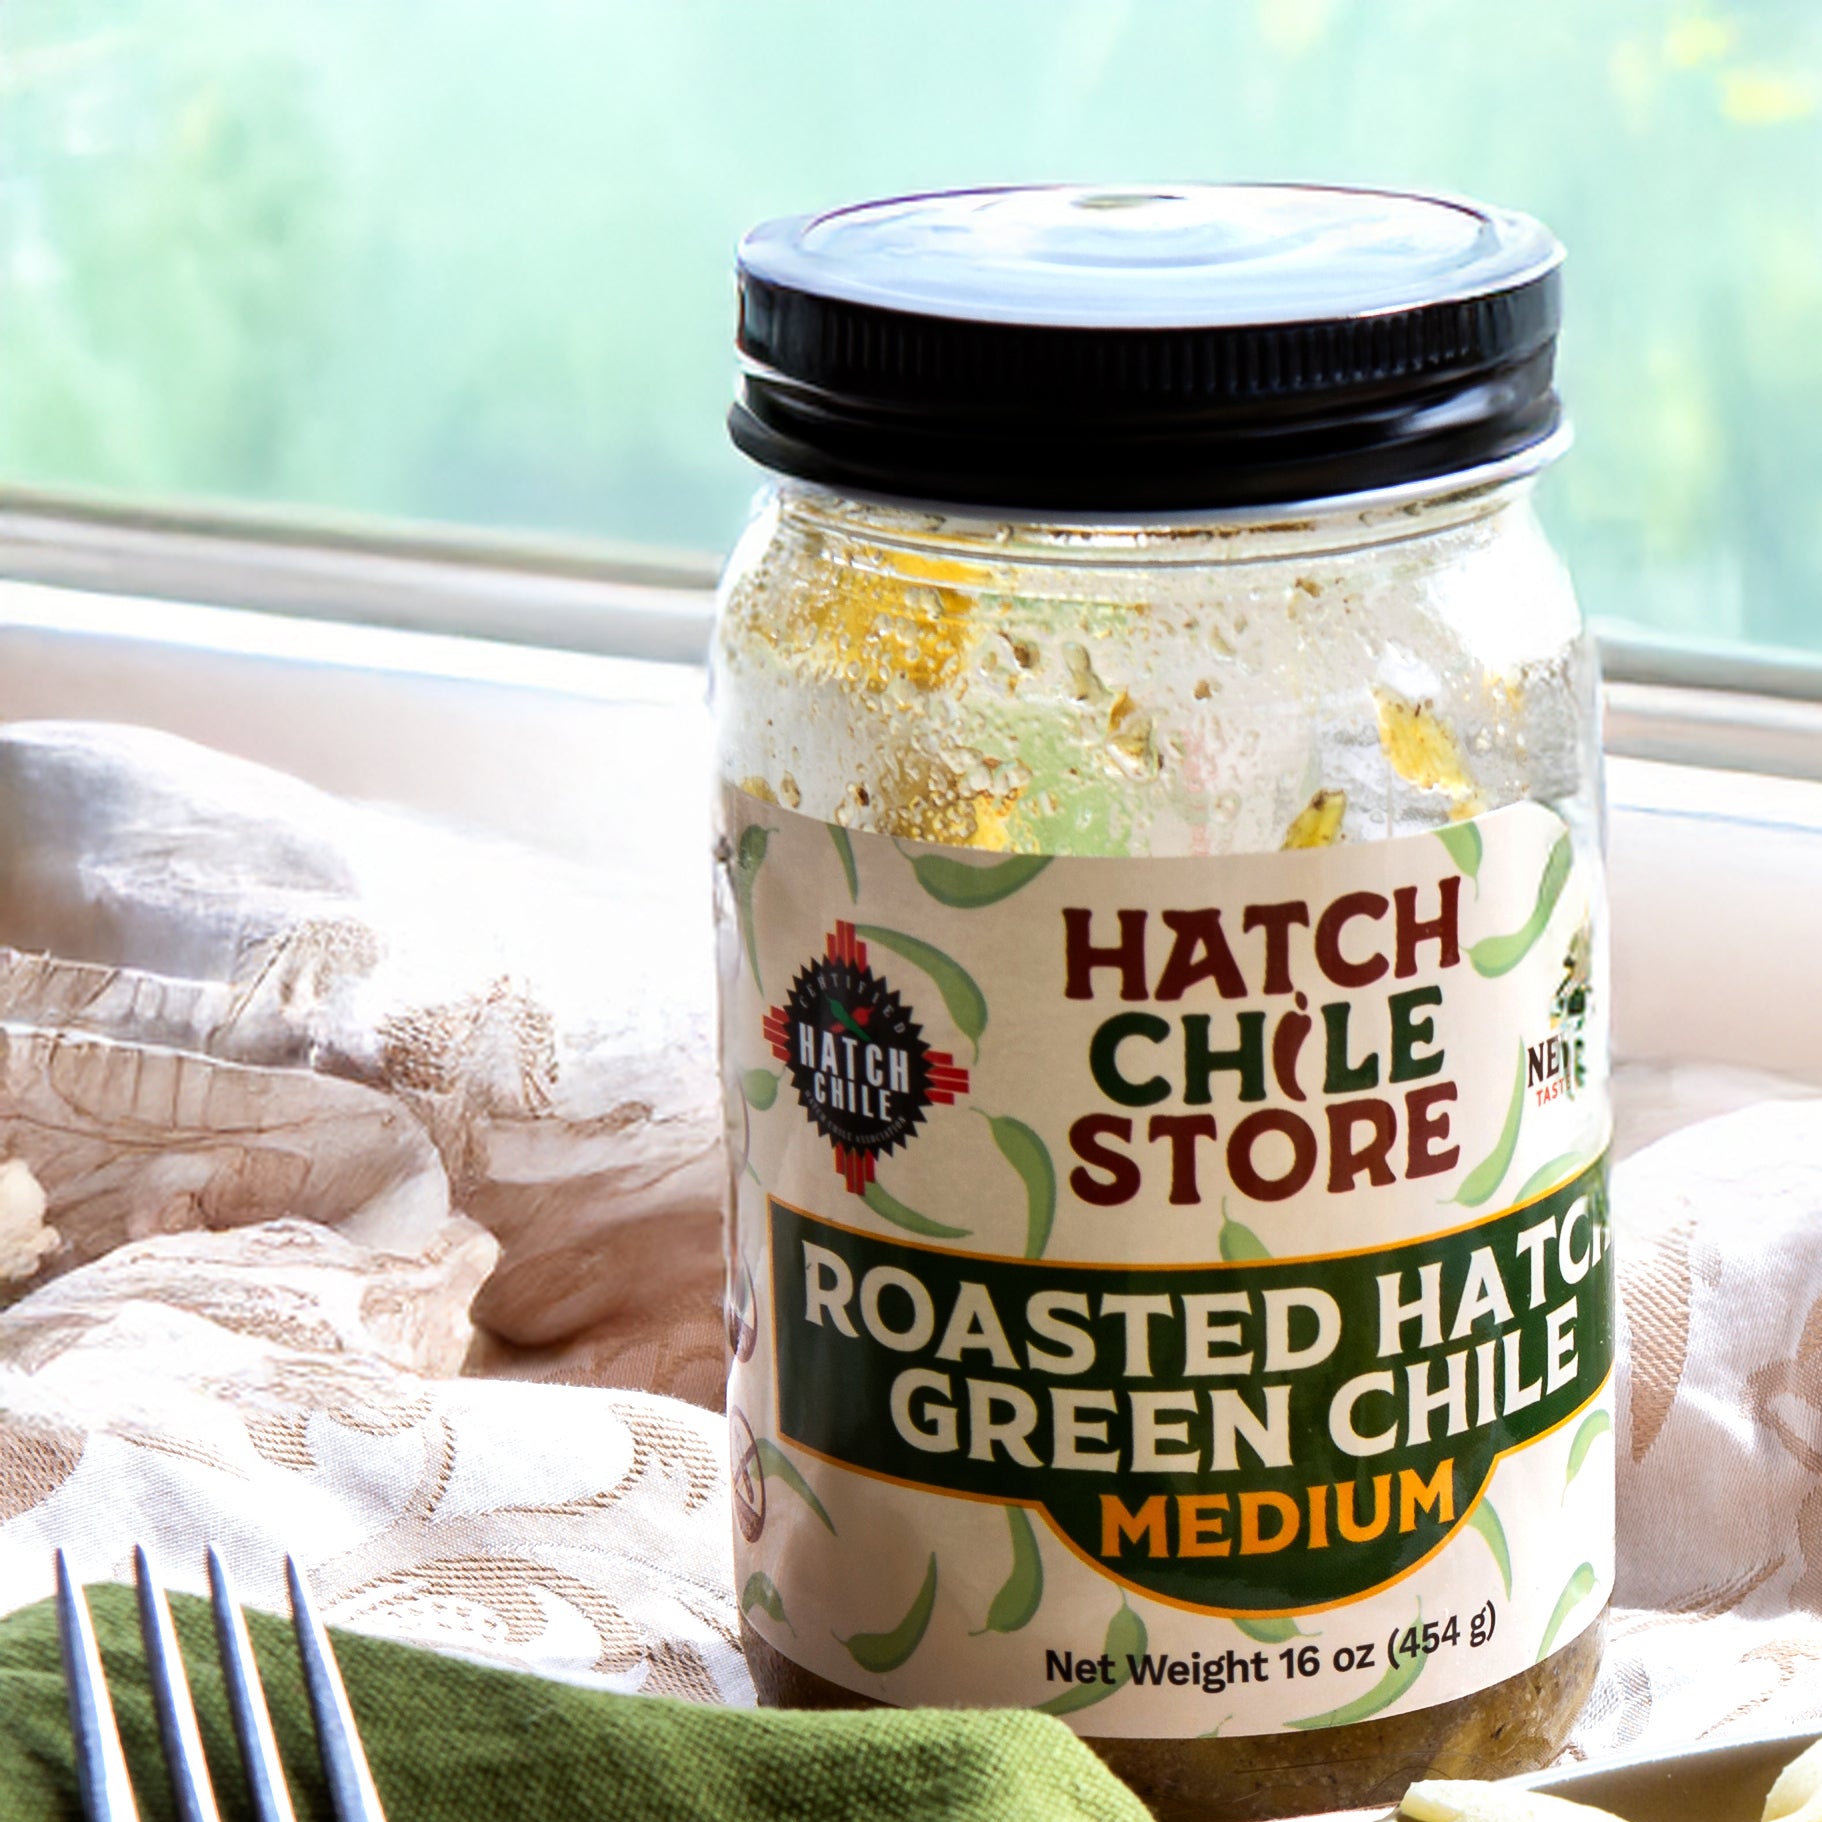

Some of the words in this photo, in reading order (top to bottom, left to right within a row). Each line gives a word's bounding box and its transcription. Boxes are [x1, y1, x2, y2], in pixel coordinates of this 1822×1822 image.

[1062, 876, 1460, 1001] HATCH
[799, 972, 906, 1034] CERTIFIED
[799, 1022, 909, 1093] HATCH
[1089, 985, 1445, 1107] CHILE
[814, 1072, 892, 1122] CHILE
[1069, 1081, 1460, 1207] STORE
[802, 1239, 1342, 1377] ROASTED
[890, 1367, 1293, 1474] GREEN
[1329, 1295, 1578, 1457] CHILE
[1099, 1457, 1457, 1559] MEDIUM
[1045, 1647, 1116, 1686] Net
[1126, 1650, 1269, 1694] Weight
[1279, 1645, 1321, 1679] 16
[1333, 1642, 1376, 1673] oz
[1387, 1615, 1462, 1671] (454
[1470, 1599, 1497, 1648] g)
